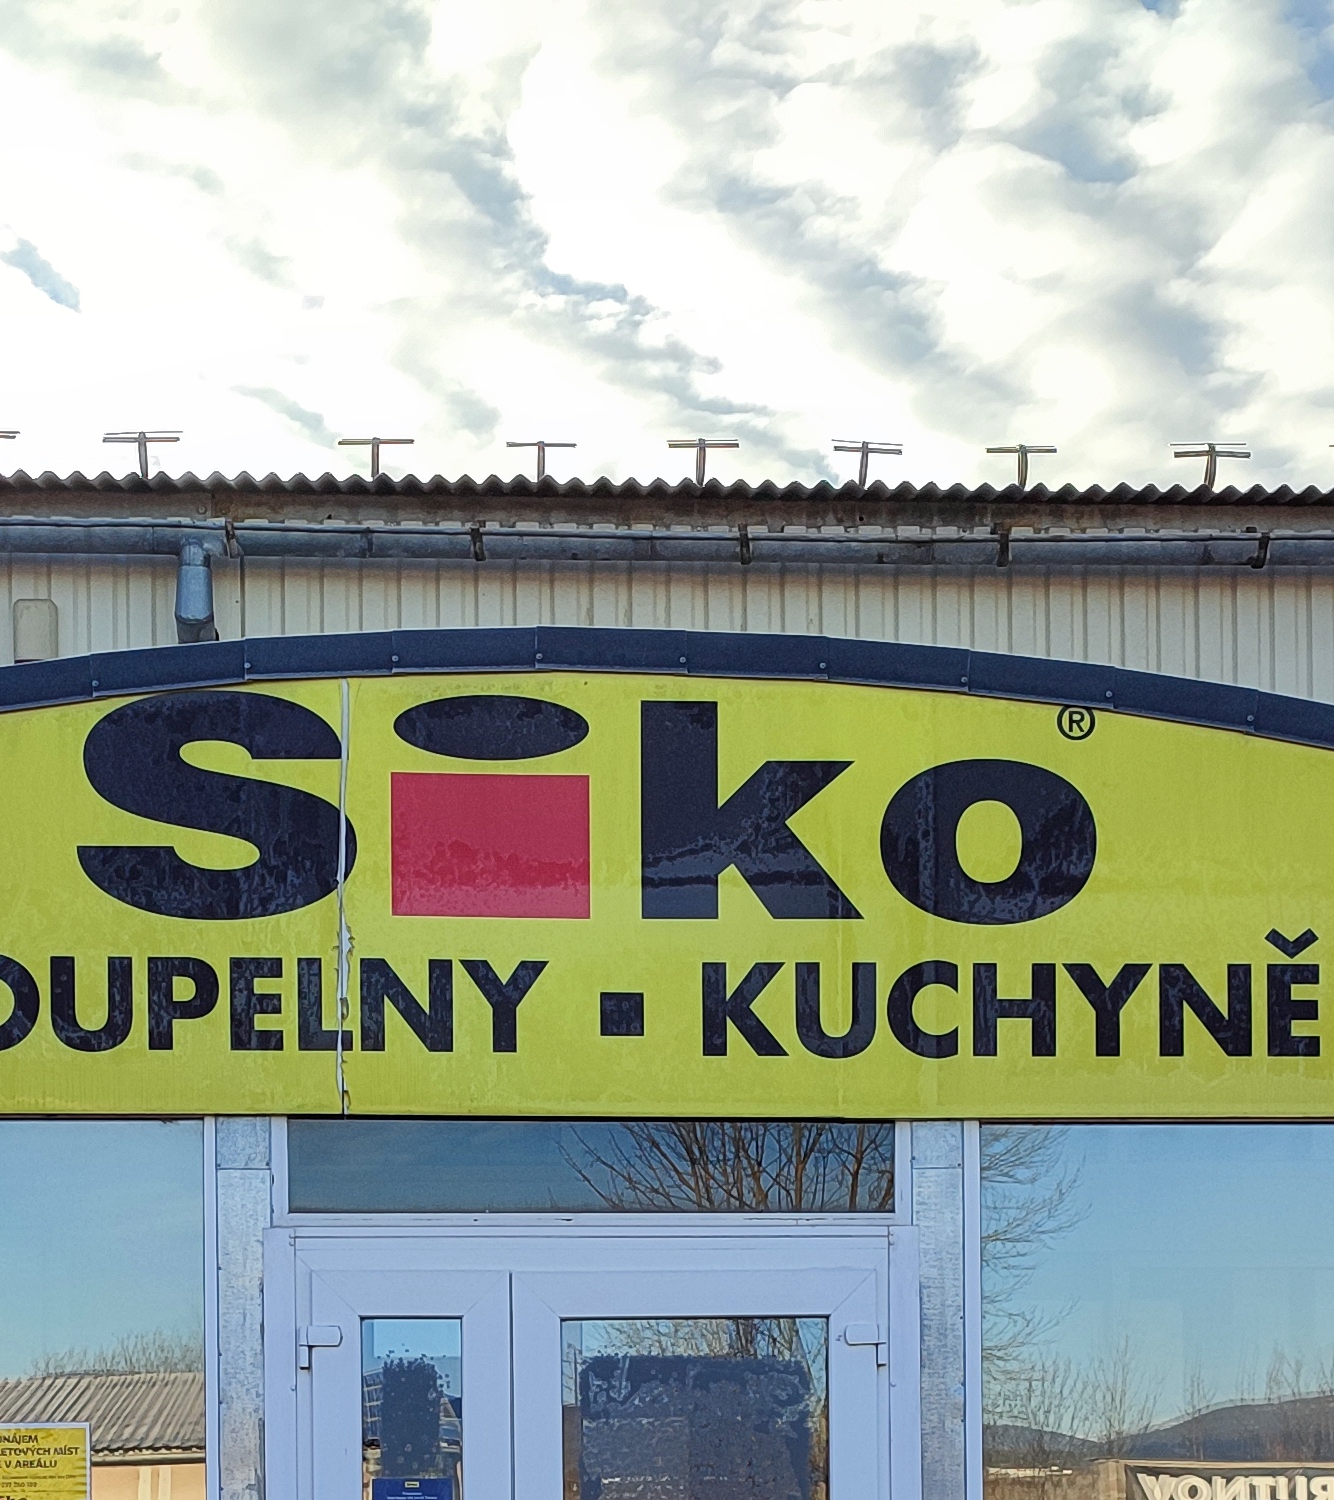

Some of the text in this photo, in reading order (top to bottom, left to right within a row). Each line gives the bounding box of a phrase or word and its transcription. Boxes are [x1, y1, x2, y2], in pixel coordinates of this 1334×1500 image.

[701, 927, 1322, 1059] KUCHYNĚ
[53, 1444, 80, 1456] MÍST
[4, 1460, 12, 1469] V
[14, 1457, 58, 1469] AREÁLU
